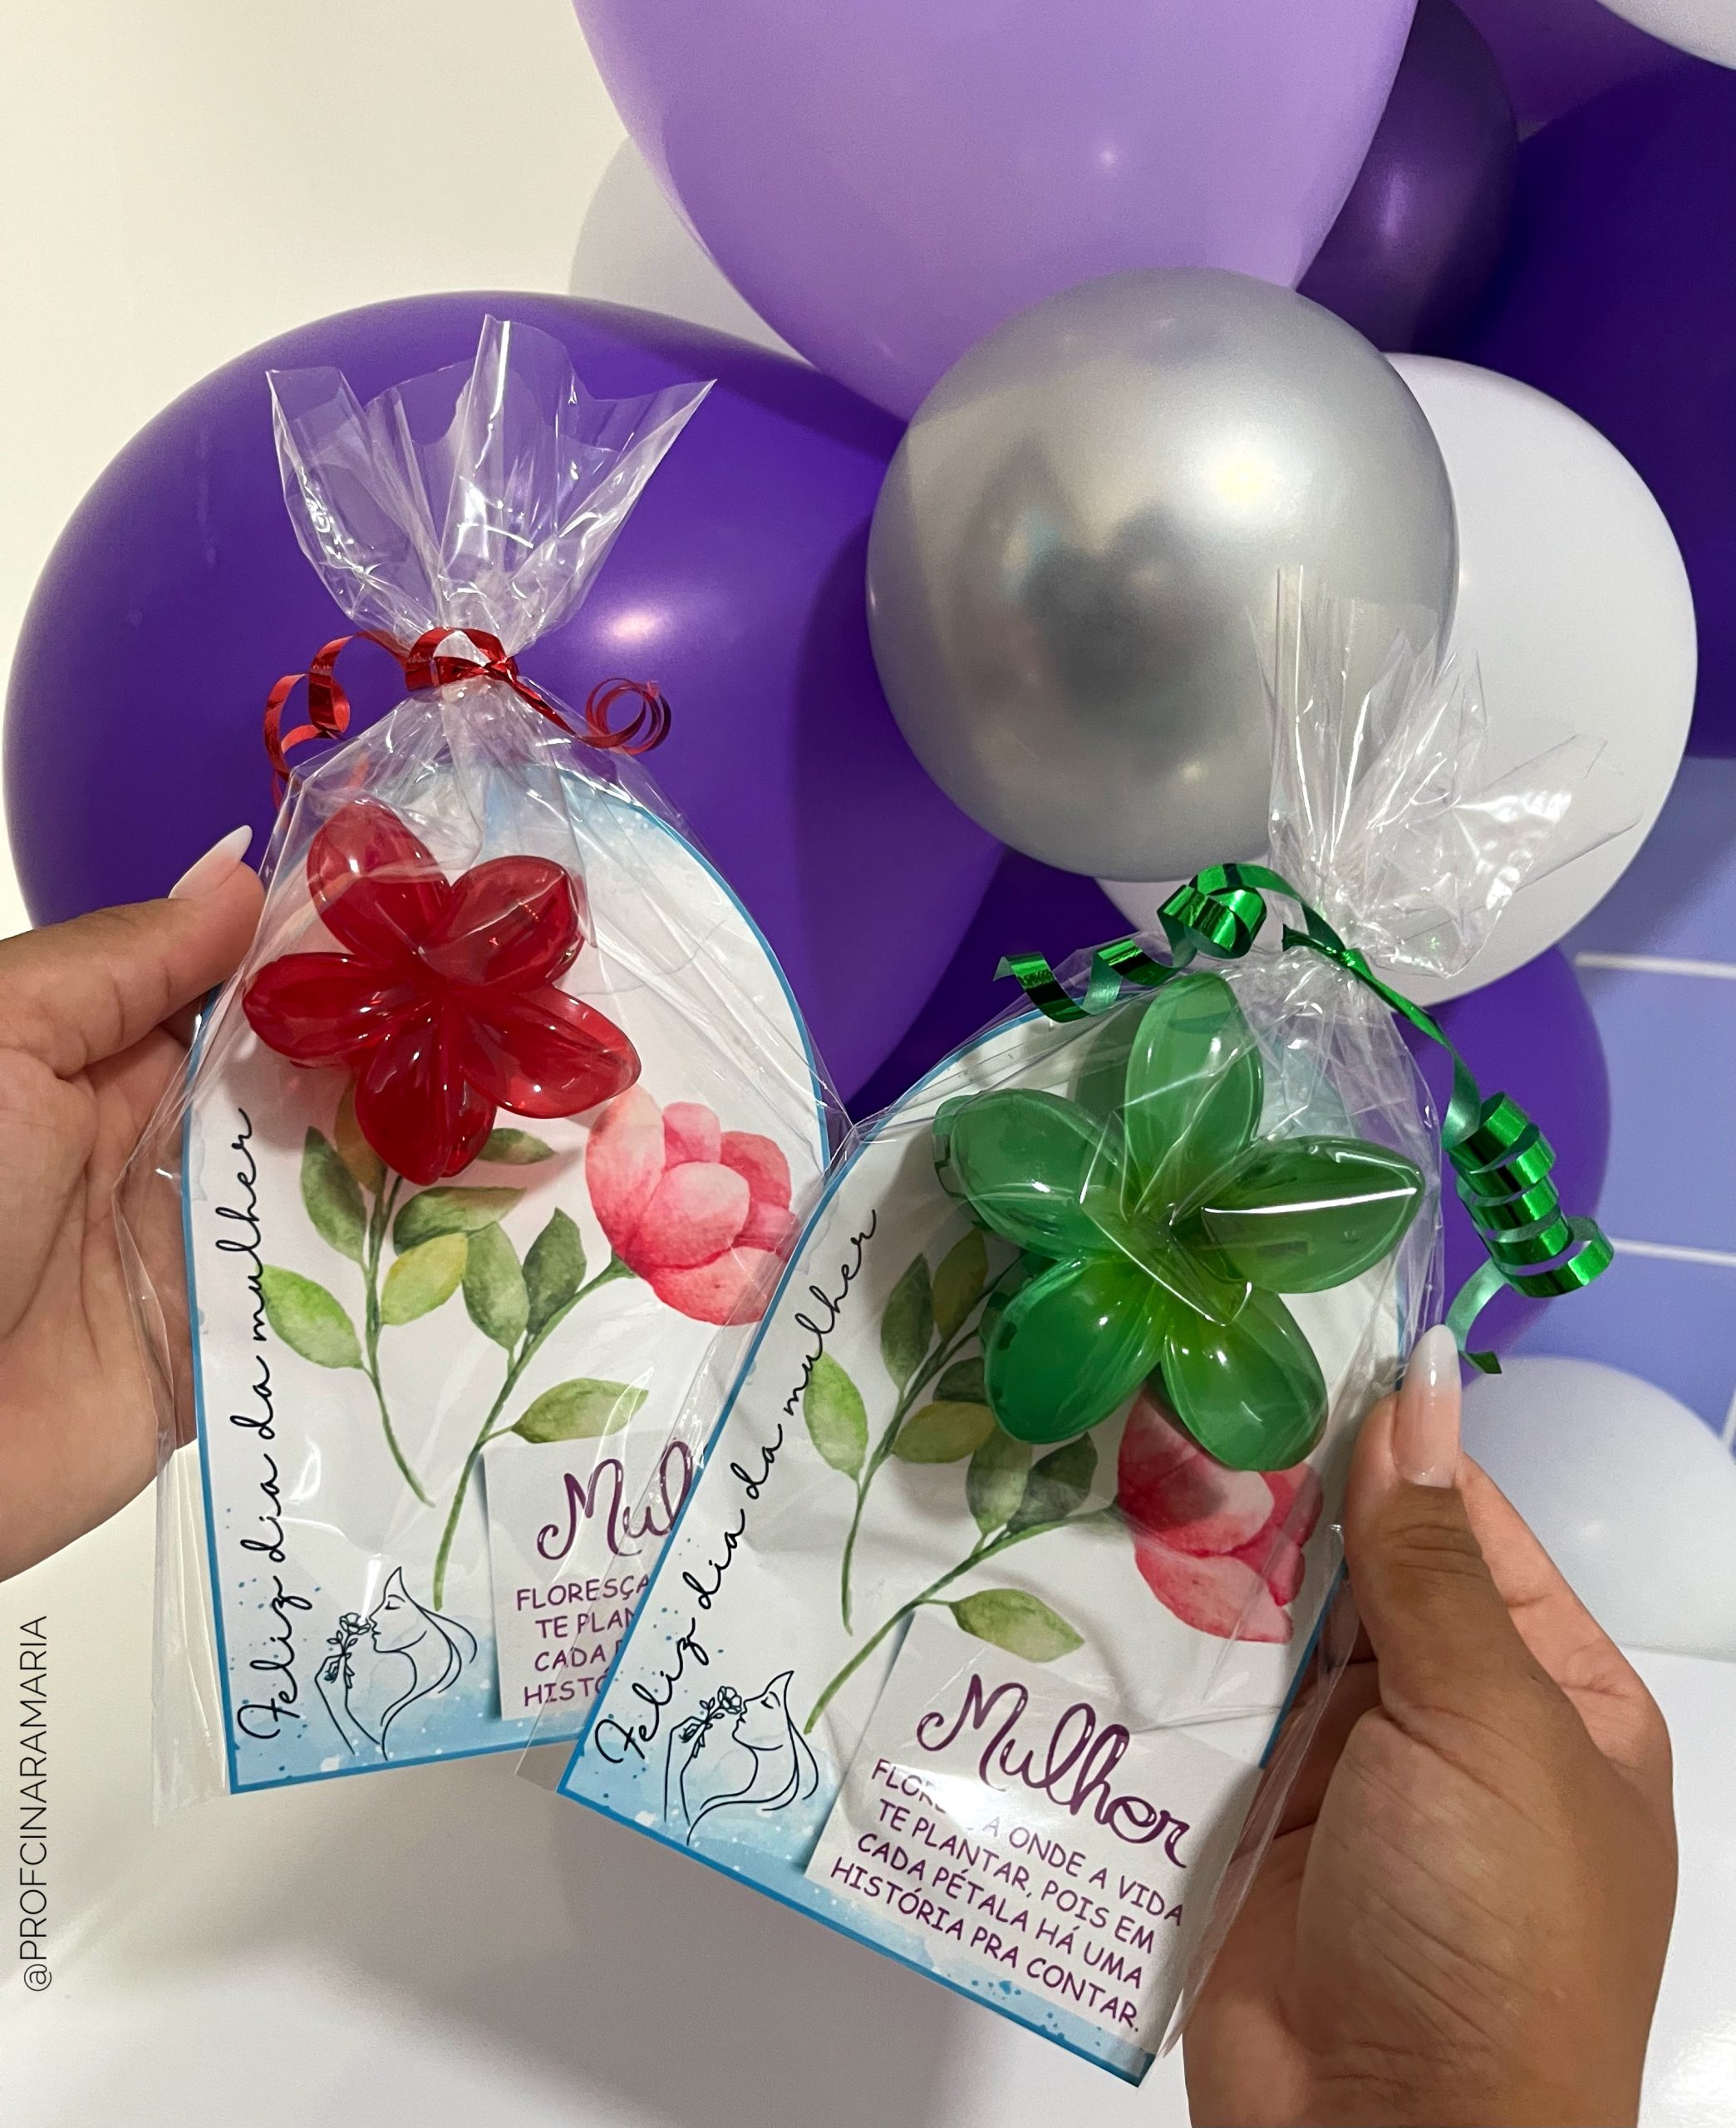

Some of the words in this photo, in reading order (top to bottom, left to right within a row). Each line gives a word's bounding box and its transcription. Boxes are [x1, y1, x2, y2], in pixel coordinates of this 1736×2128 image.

[215, 1107, 267, 1342] mulher
[228, 1355, 276, 1440] da
[239, 1453, 286, 1564] dia
[536, 1440, 709, 1561] Mul
[594, 1617, 709, 1763] Feliz
[682, 1509, 745, 1609] dia
[730, 1424, 784, 1500] da
[783, 1209, 877, 1416] mulher
[237, 1575, 312, 1739] Feliz
[534, 1615, 568, 1639] TE
[534, 1643, 607, 1672] CADA
[917, 1673, 1191, 1869] Mulher
[830, 1857, 963, 1940] HISTÓRIA
[971, 1926, 1018, 1969] PRA
[1026, 1958, 1139, 2032] CONTAR.
[858, 1833, 924, 1881] CADA
[932, 1868, 1029, 1931] PÉTALA
[1036, 1919, 1074, 1955] HÁ
[1084, 1943, 1143, 1988] UMA
[879, 1798, 911, 1832] TE
[912, 1817, 1032, 1899] PLANTAR,
[1042, 1881, 1108, 1928] POIS
[1114, 1916, 1154, 1953] EM
[1009, 1827, 1085, 1878] ONDE
[1089, 1868, 1107, 1889] A
[1119, 1875, 1184, 1926] VIDA
